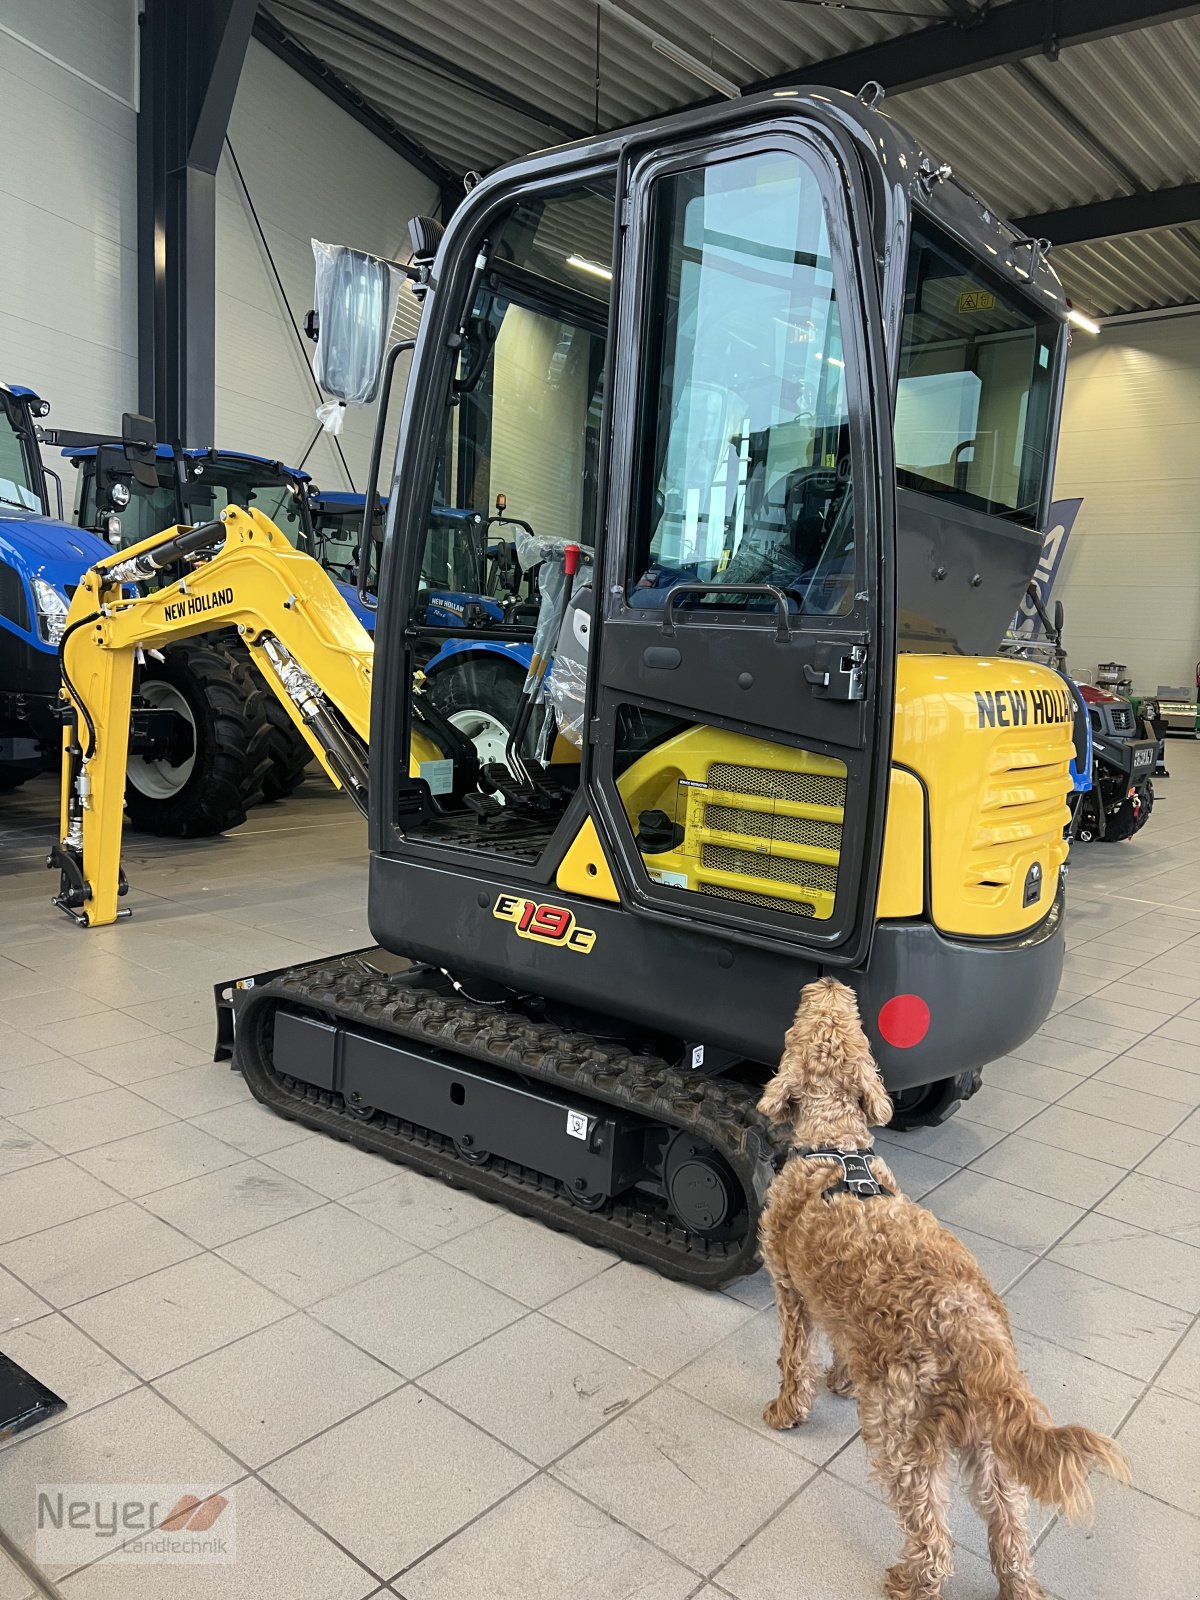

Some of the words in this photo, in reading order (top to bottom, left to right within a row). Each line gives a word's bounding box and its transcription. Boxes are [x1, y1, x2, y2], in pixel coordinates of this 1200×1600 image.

[164, 601, 186, 622] NEW
[187, 587, 234, 615] HOLLAND
[431, 598, 443, 606] NEW
[444, 601, 465, 612] HOLLAN
[974, 690, 1028, 728] NEW
